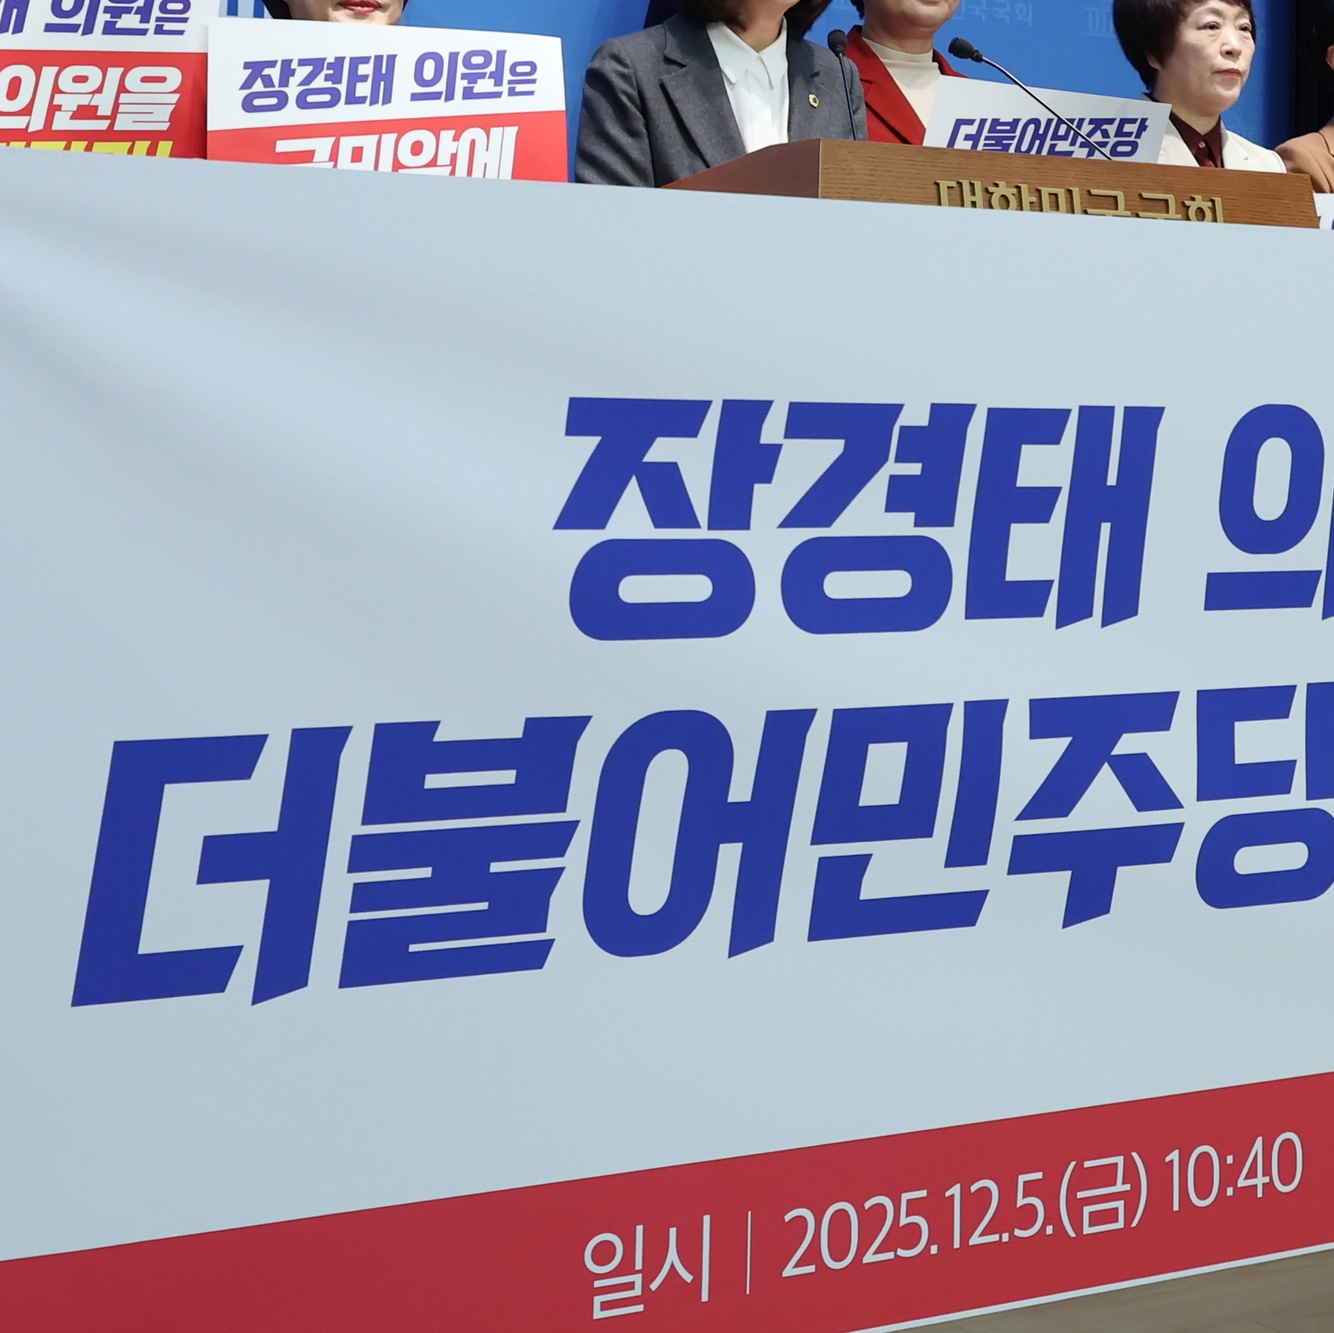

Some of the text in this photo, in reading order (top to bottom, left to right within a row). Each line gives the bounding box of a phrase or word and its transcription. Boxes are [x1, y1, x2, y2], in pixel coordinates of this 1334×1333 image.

[238, 49, 539, 114] 장경태 의원은
[947, 116, 1149, 158] 더불어민주당
[552, 397, 1166, 641] 장경태
[584, 1214, 711, 1320] 일시
[781, 1154, 1149, 1279] 2025.12.5.(금)
[1169, 1131, 1303, 1213] 10:40
